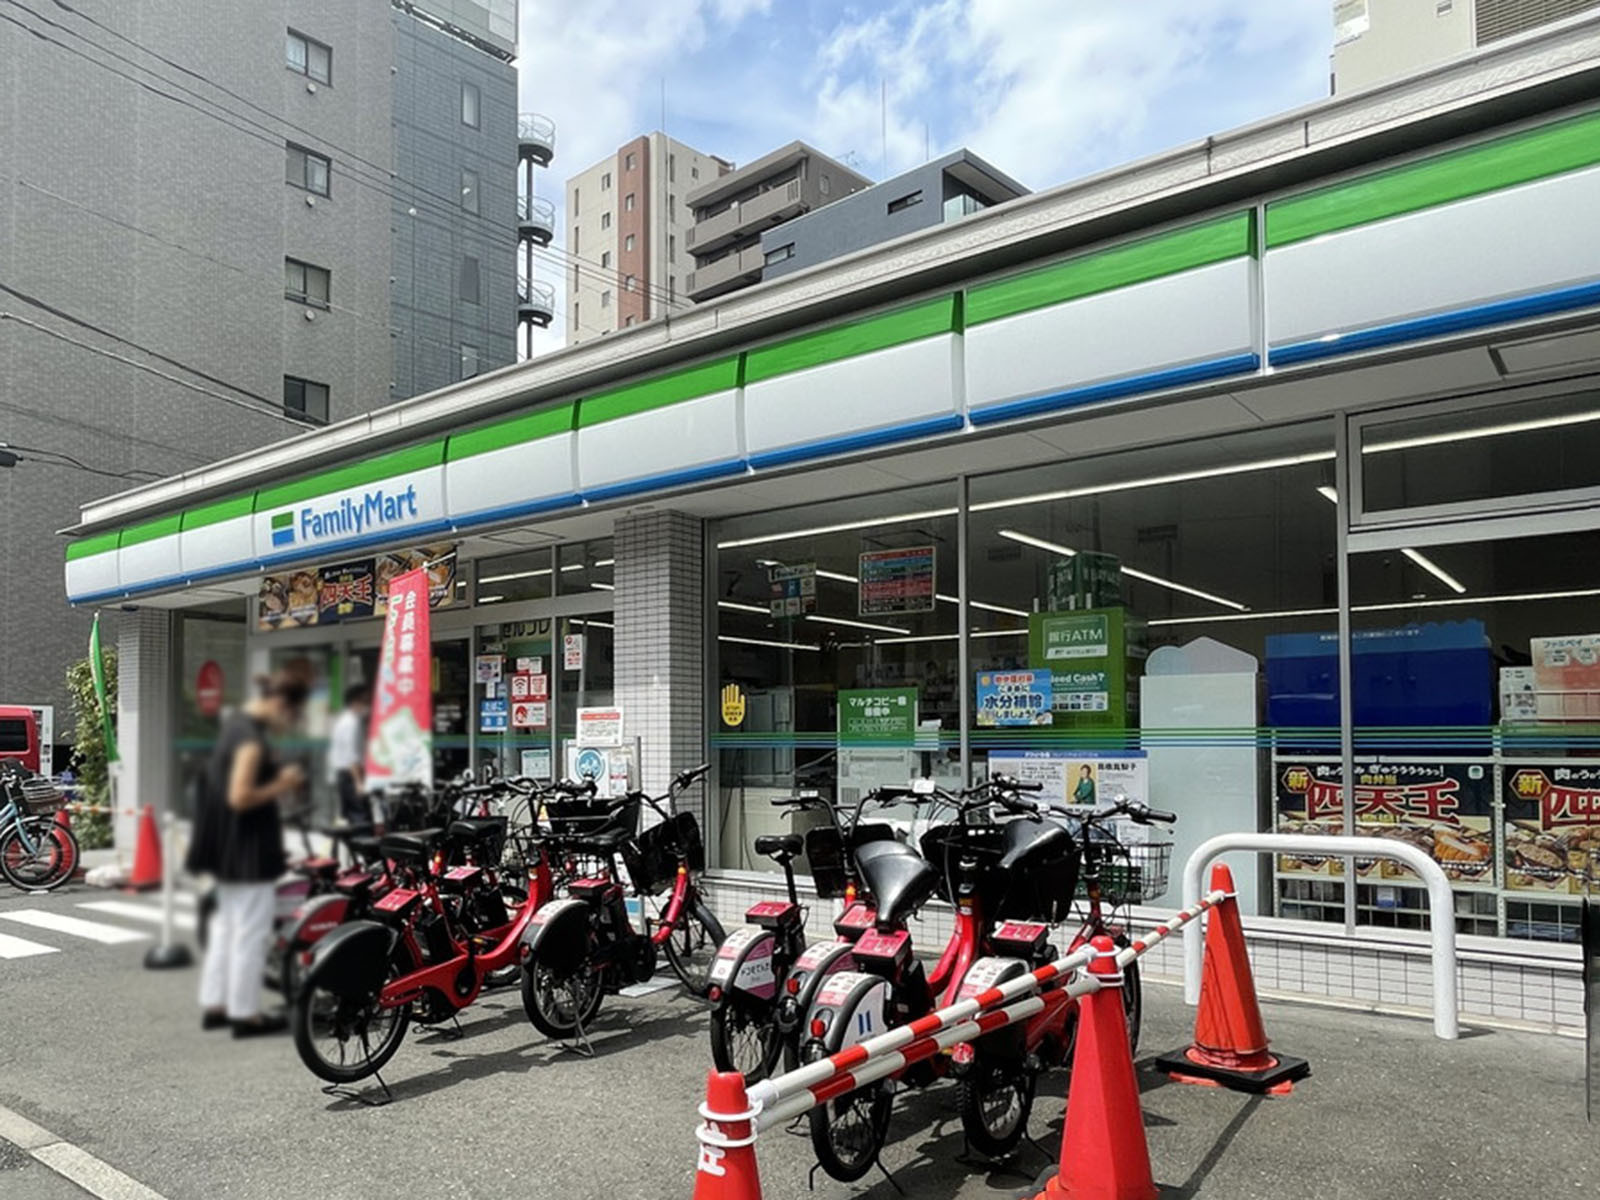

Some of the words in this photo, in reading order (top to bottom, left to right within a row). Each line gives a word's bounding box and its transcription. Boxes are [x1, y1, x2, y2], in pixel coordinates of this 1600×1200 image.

[301, 485, 417, 539] FamilyMart
[320, 573, 373, 612] 四天王
[1050, 629, 1102, 643] 銀行ATM
[1073, 672, 1105, 683] Cash?
[985, 694, 1043, 710] 水分補給
[1287, 771, 1307, 789] 新
[1518, 774, 1542, 794] 新
[1306, 778, 1460, 827] 四天王
